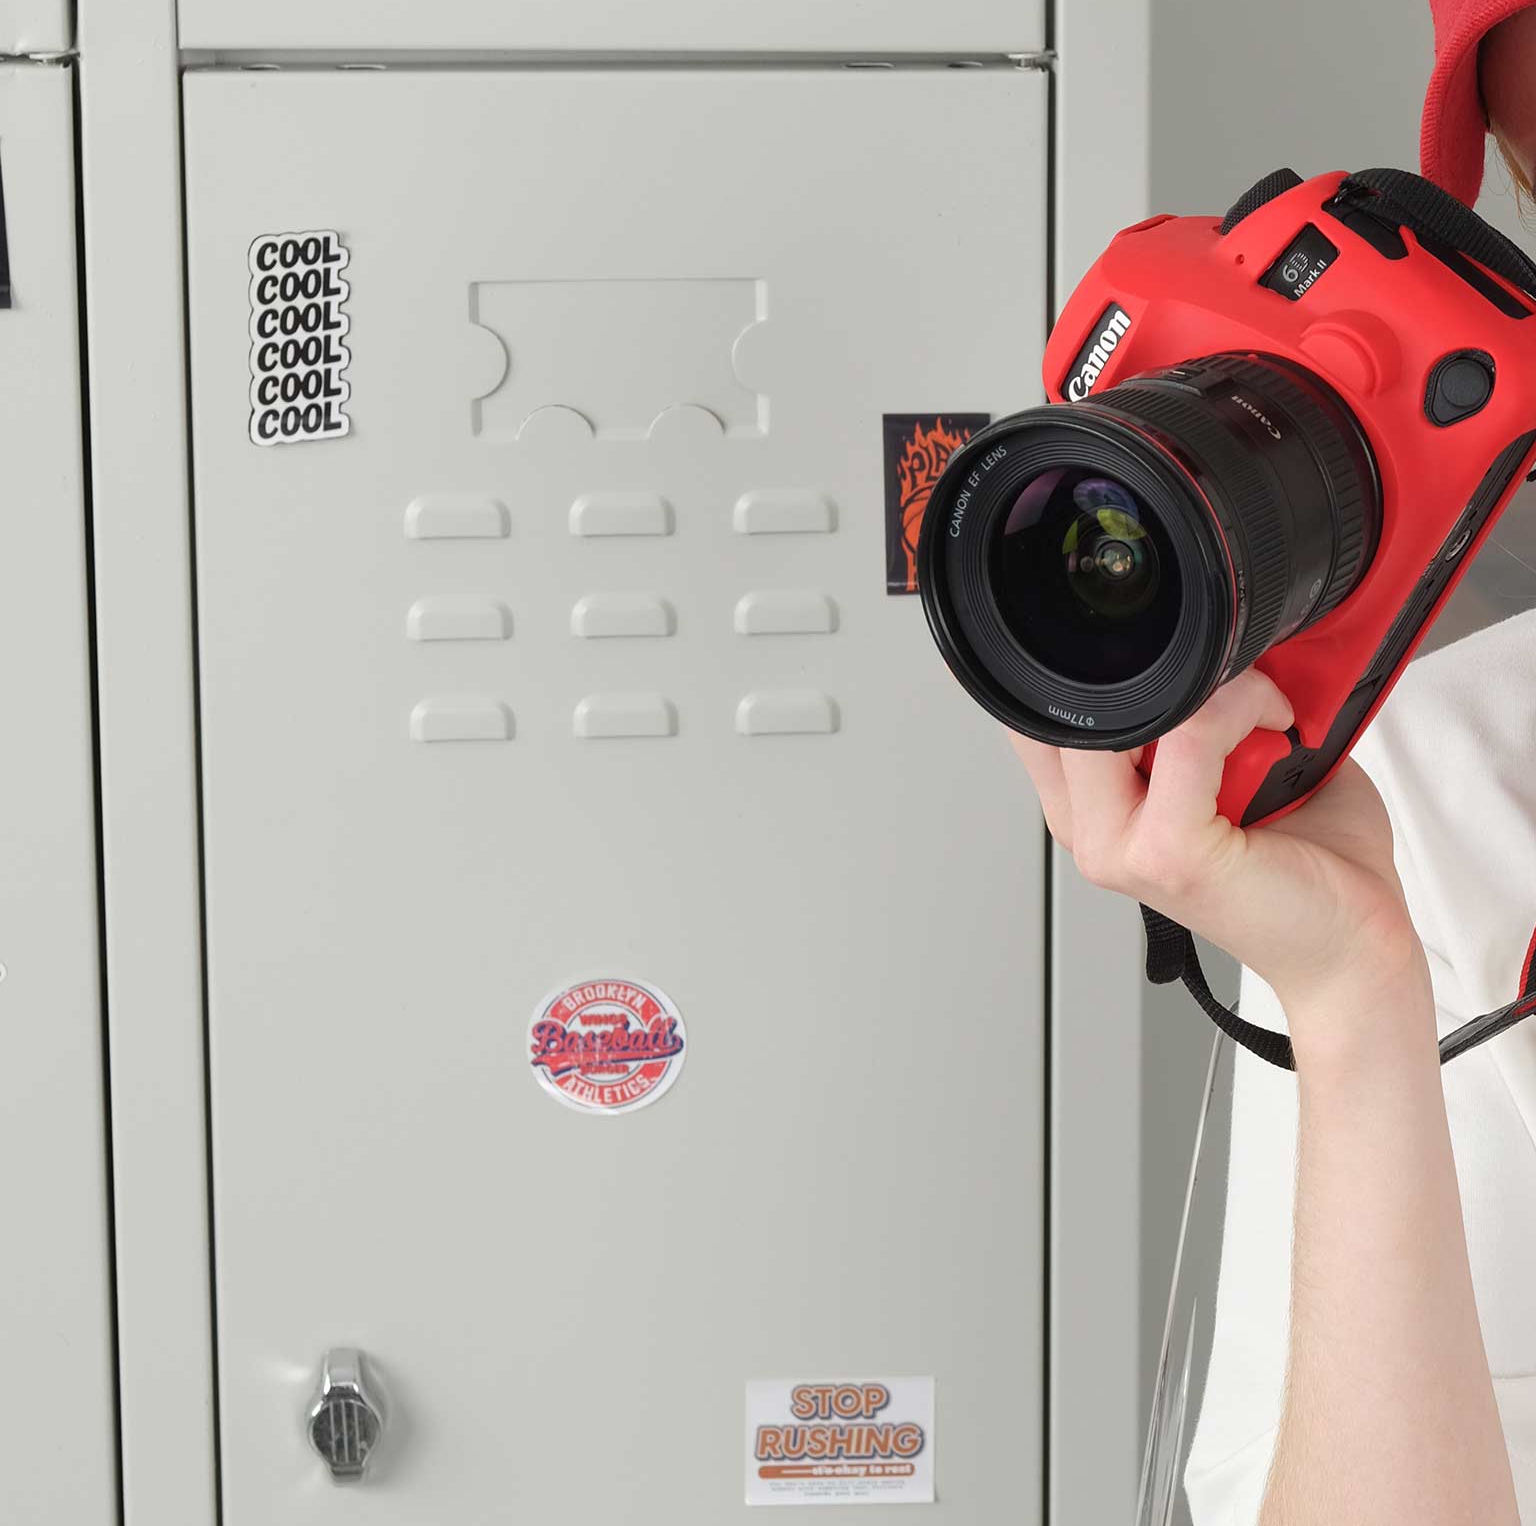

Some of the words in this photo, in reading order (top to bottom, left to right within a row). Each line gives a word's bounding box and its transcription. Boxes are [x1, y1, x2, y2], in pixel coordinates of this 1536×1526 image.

[256, 236, 341, 271] COOL
[257, 267, 341, 305] COOL
[1294, 269, 1320, 297] Mark
[257, 301, 342, 339] COOL
[257, 334, 342, 372] COOL
[1069, 311, 1131, 402] Canon
[258, 368, 342, 406] COOL
[258, 401, 342, 439] COOL
[1232, 396, 1281, 439] Canon
[950, 490, 971, 537] CANON
[968, 471, 981, 487] EF
[981, 445, 1008, 472] LENS
[563, 984, 648, 1011] BROOKLYN
[563, 1074, 650, 1104] ATHLETICS
[791, 1384, 890, 1420] STOP
[755, 1423, 924, 1461] RUSHING
[869, 1465, 883, 1474] to
